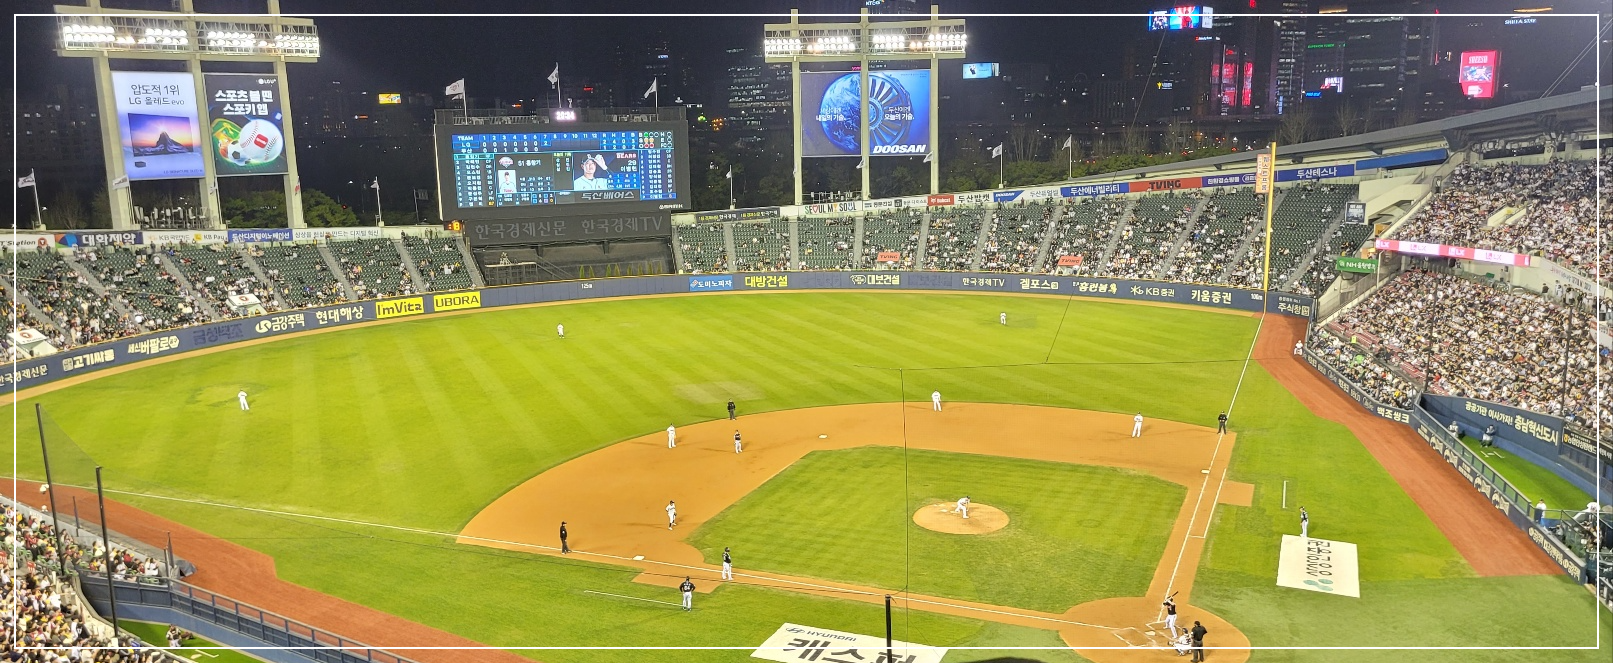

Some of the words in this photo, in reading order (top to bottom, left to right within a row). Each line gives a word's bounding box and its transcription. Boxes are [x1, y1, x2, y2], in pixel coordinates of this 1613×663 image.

[130, 85, 161, 96] 압도적
[164, 86, 180, 96] 1위
[129, 97, 142, 105] LG
[145, 97, 170, 105] 올레드
[215, 90, 248, 103] 스포츠
[223, 103, 256, 116] 스포키
[256, 103, 269, 116] 앱
[556, 112, 576, 120] 20:34
[873, 145, 926, 154] DOOSAN
[1297, 167, 1337, 179] 두산테스나
[1070, 184, 1120, 195] 두산에너빌리티
[1149, 180, 1181, 189] TVING
[581, 191, 635, 200] 두산베어스
[958, 194, 990, 203] 두산밥캣
[475, 221, 566, 239] 한국경제신문
[582, 216, 663, 234] 한국경제TV
[82, 233, 136, 245] 대화제약
[698, 280, 732, 288] 도미노피자
[745, 275, 788, 288] 대방건설
[868, 274, 900, 285] 대보건설
[962, 277, 1005, 287] 한국경제TV
[1145, 288, 1175, 297] KB증권
[1191, 290, 1232, 305] 키움증권
[435, 295, 479, 308] UBORA
[1278, 303, 1301, 314] 주식창
[316, 306, 364, 325] 현대해상
[272, 313, 305, 331] 금강주택
[1377, 406, 1410, 424] 백조씽크
[1465, 401, 1488, 416] 공공기관
[1488, 409, 1513, 426] 이사가자!
[1515, 415, 1559, 446] 충남혁신도시
[807, 631, 856, 642] HYUNDAI
